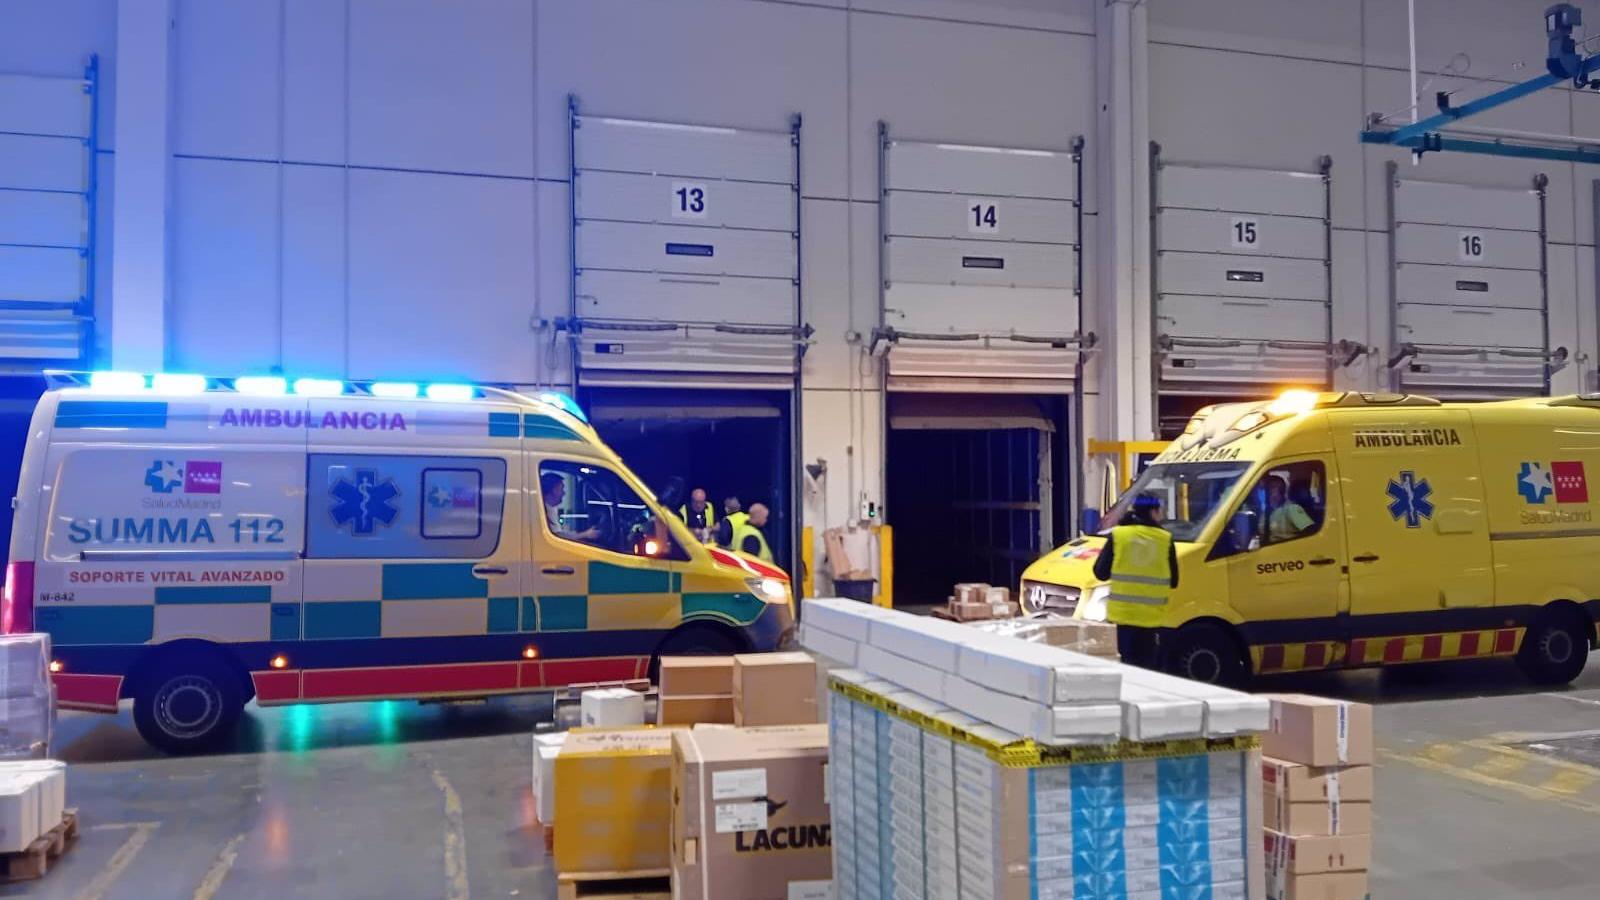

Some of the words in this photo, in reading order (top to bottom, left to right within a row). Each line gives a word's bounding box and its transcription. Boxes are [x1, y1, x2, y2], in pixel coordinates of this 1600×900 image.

[676, 188, 704, 213] 13
[971, 204, 997, 228] 14
[1234, 222, 1257, 244] 15
[1462, 235, 1482, 256] 16
[219, 408, 408, 431] AMBULANCIA
[1355, 428, 1461, 448] AMBULANCIA
[67, 517, 215, 544] SUMMA
[228, 518, 285, 543] 112
[69, 570, 145, 583] SOPORTE
[150, 570, 196, 583] VITAL
[200, 570, 285, 583] AVANZADO
[1256, 560, 1305, 575] serveo
[40, 592, 75, 602] M-842
